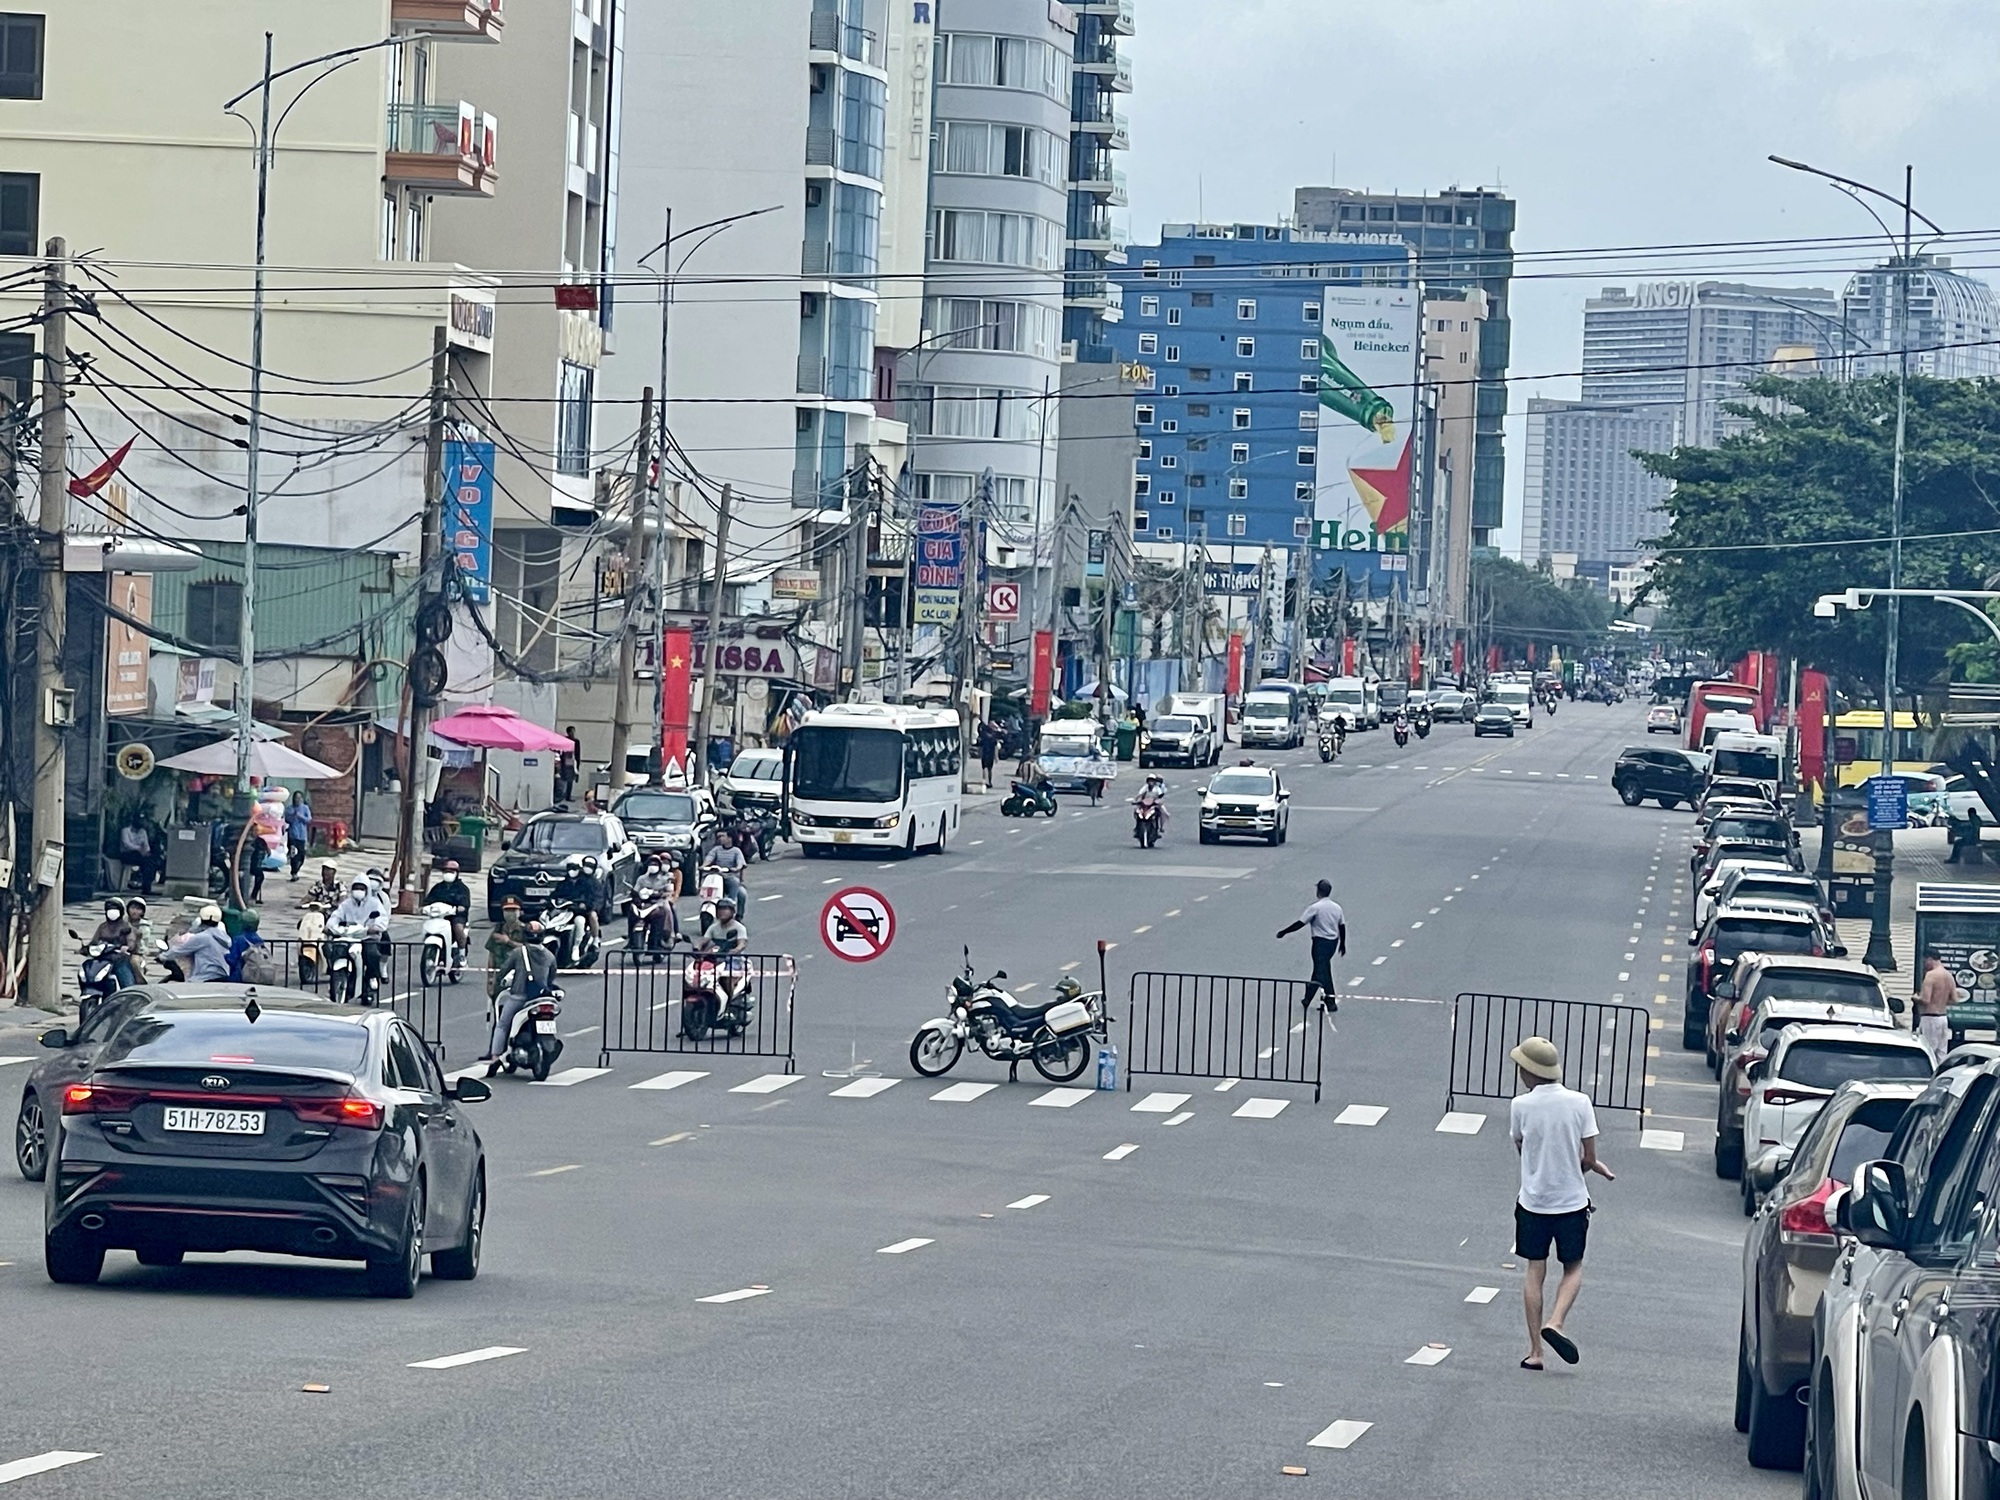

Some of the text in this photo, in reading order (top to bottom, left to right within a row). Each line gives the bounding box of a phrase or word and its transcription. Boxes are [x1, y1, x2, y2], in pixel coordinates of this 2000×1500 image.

[909, 37, 928, 161] HOTEL
[1328, 232, 1358, 244] SEA
[1359, 233, 1406, 245] HOTEL
[1331, 318, 1365, 331] Ngụm
[1354, 340, 1410, 352] Heineken
[455, 465, 482, 571] VOLGA
[924, 540, 954, 559] GIA
[918, 560, 958, 587] ĐÌNH
[206, 1078, 225, 1087] KIA
